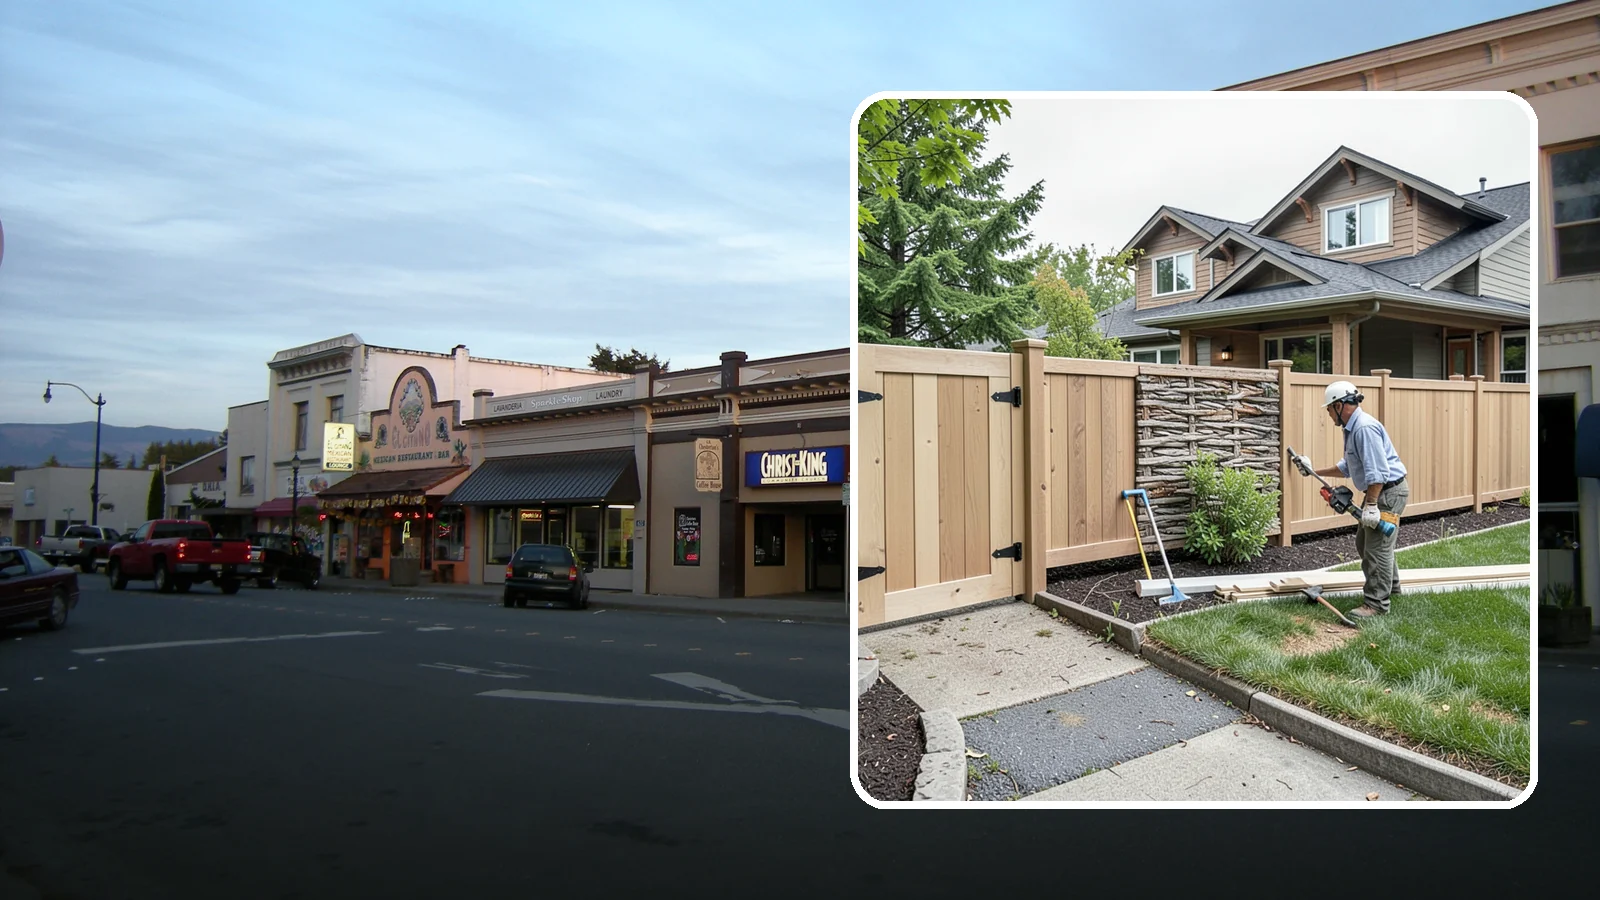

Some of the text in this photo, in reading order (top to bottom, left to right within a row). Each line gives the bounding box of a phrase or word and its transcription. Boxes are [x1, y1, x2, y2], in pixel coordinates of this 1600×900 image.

[595, 389, 624, 400] LAUNDRY
[493, 402, 522, 413] LAVANDERIA
[530, 394, 583, 409] Sparkle Shop
[373, 454, 396, 464] MEXICAN
[397, 451, 434, 463] RESTAURANT
[438, 450, 450, 460] BAR
[760, 451, 797, 478] CHRIST
[798, 450, 827, 477] KING
[696, 481, 722, 489] Coffee House
